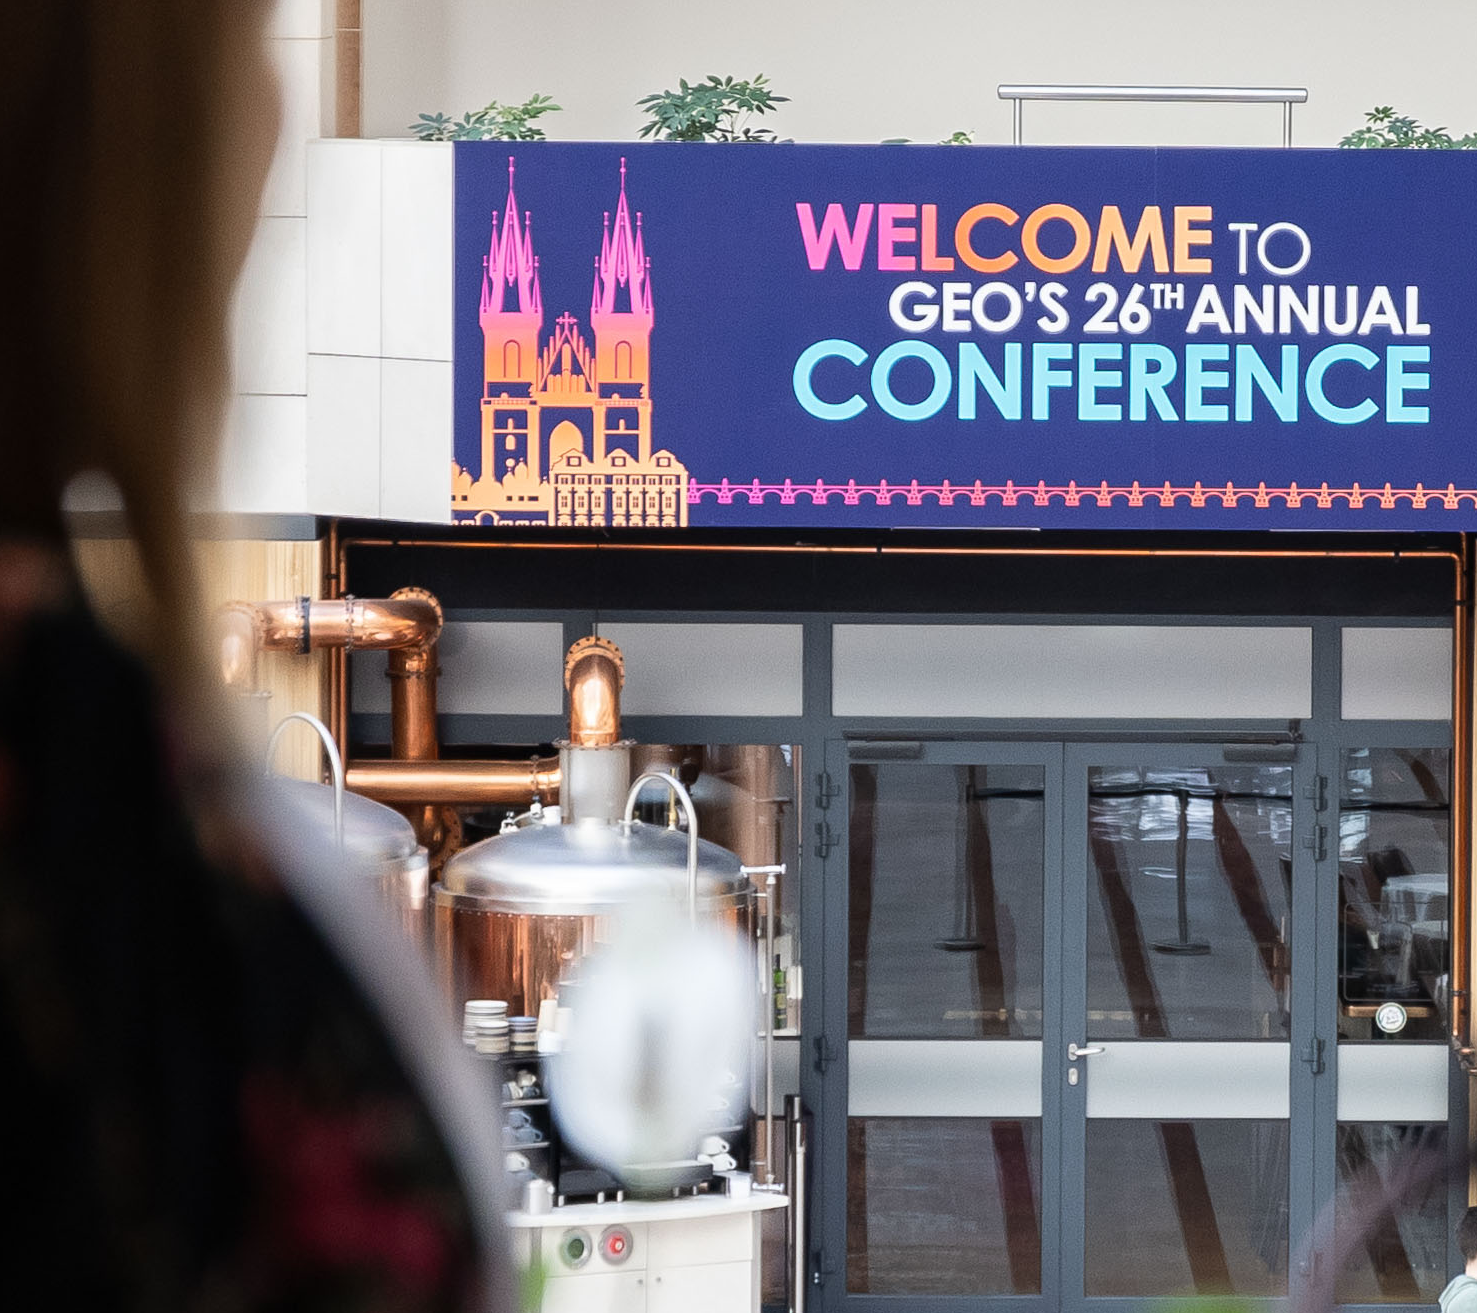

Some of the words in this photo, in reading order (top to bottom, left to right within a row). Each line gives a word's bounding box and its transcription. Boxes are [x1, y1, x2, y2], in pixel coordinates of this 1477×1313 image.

[795, 203, 1213, 273] WELCOME
[1228, 222, 1311, 275] TO
[888, 281, 1071, 333] GEO'S
[1083, 282, 1184, 334] 26TH
[1185, 284, 1431, 336] ANNUAL
[792, 338, 1431, 424] CONFERENCE
